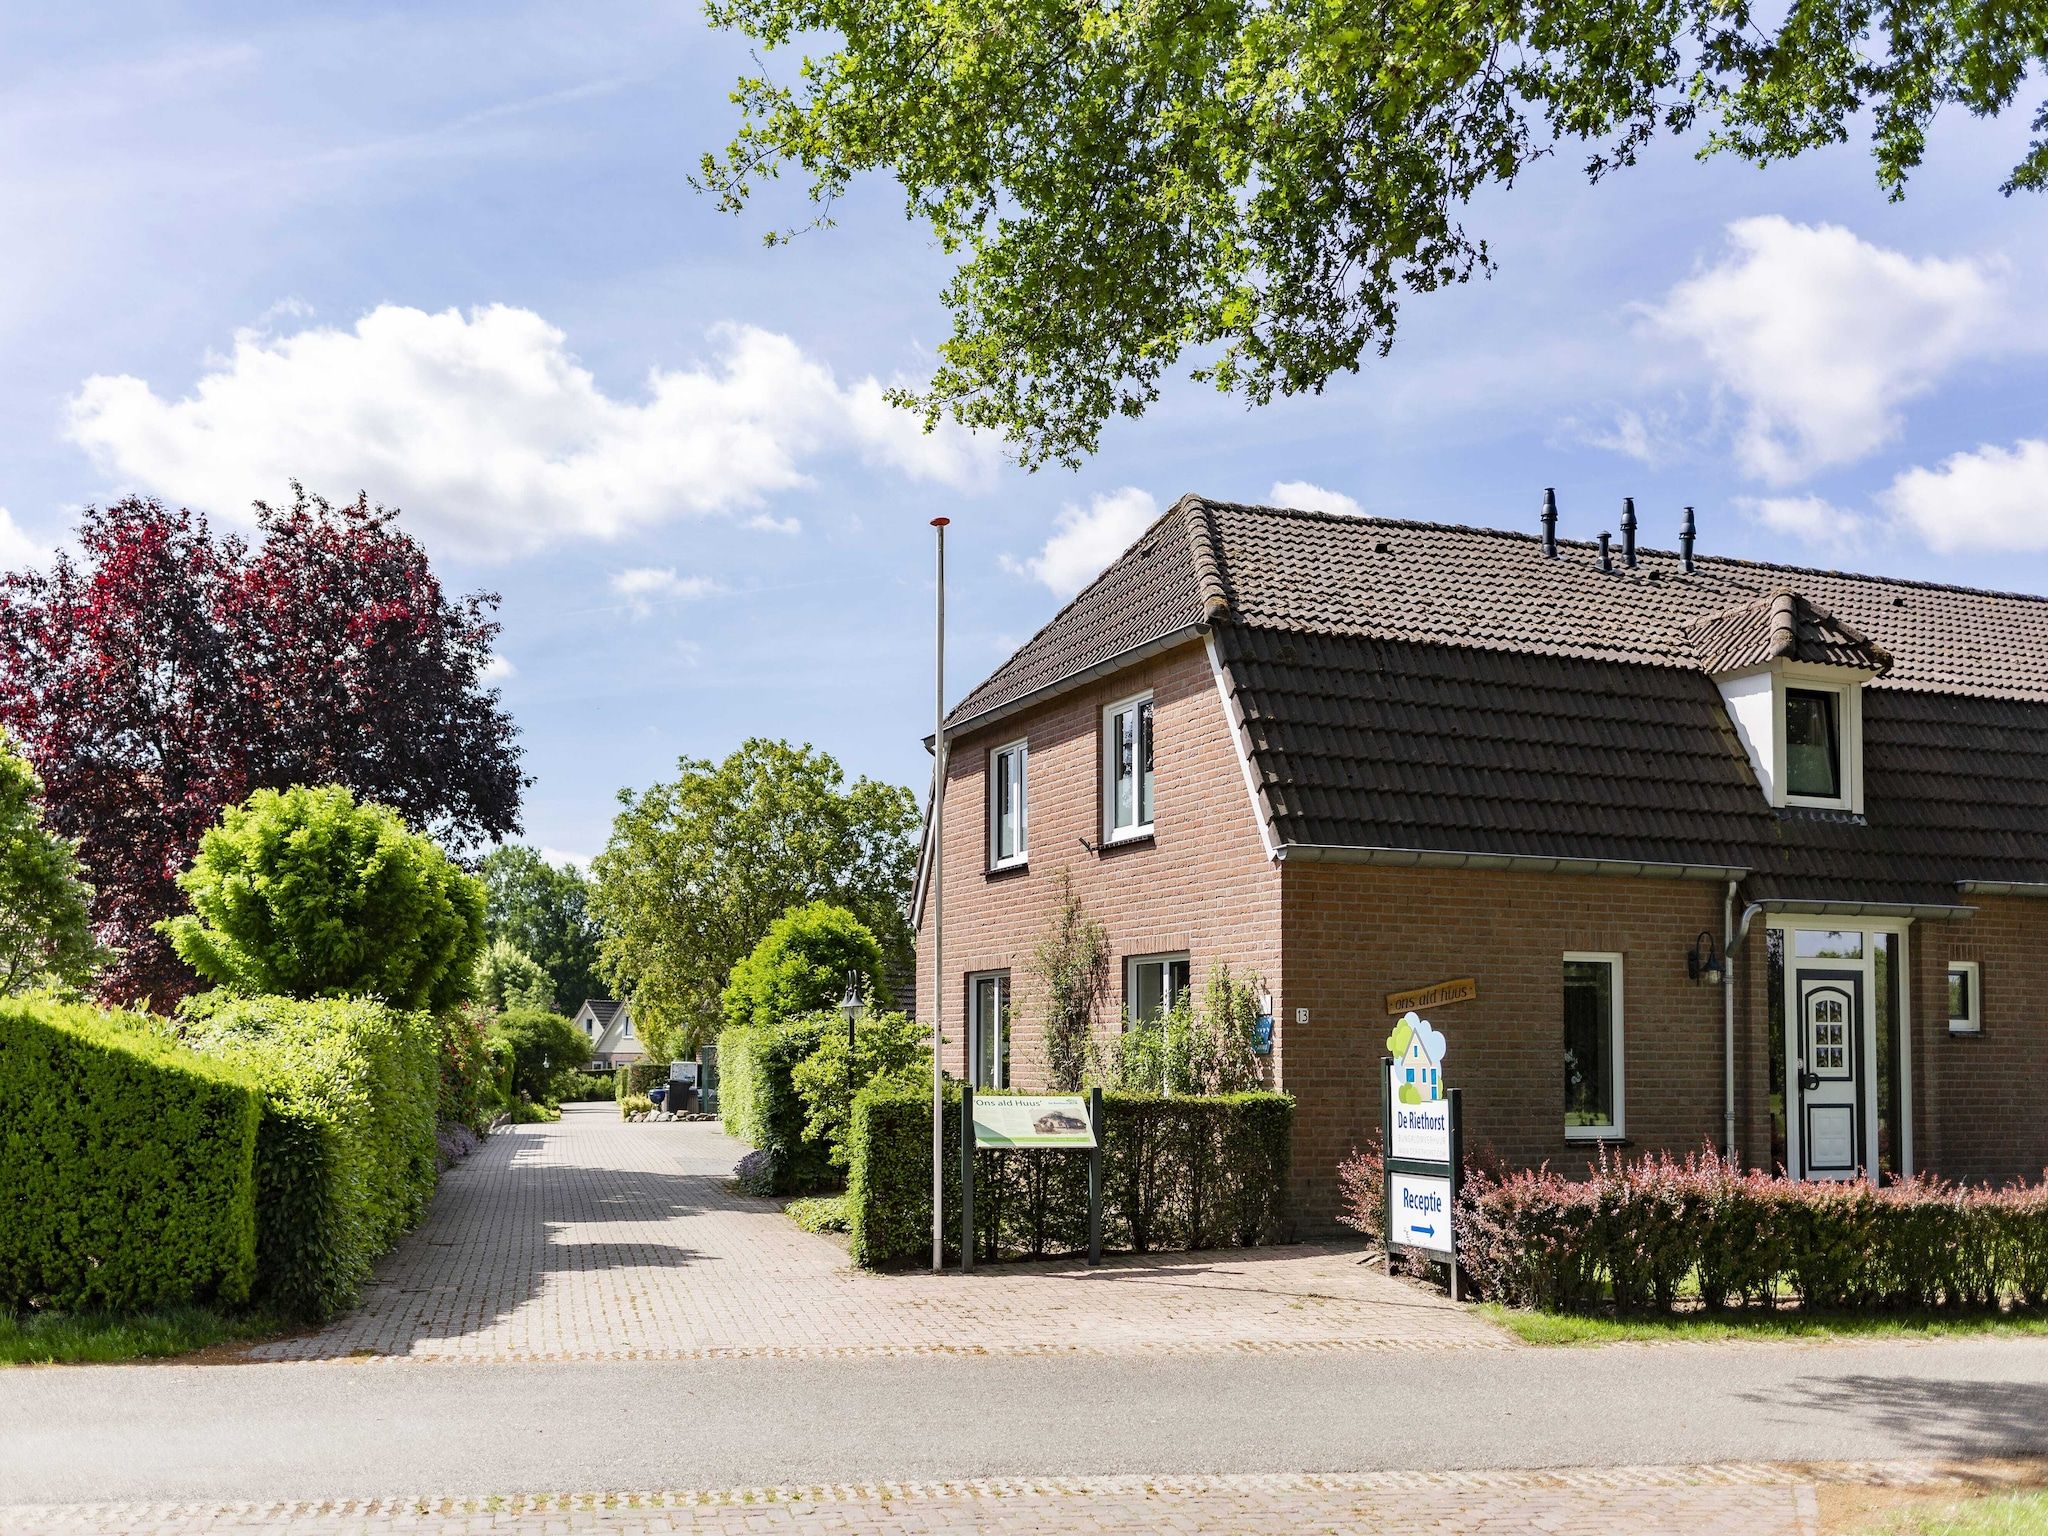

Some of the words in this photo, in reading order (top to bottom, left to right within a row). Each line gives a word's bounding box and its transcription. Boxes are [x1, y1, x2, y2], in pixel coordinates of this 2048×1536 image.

[1395, 998, 1414, 1010] ons
[1441, 986, 1467, 1001] huus
[1297, 1010, 1308, 1022] 13
[998, 1099, 1013, 1107] ald
[1397, 1111, 1408, 1128] De
[1409, 1111, 1445, 1131] Riethorst
[1403, 1187, 1442, 1216] Receptie
